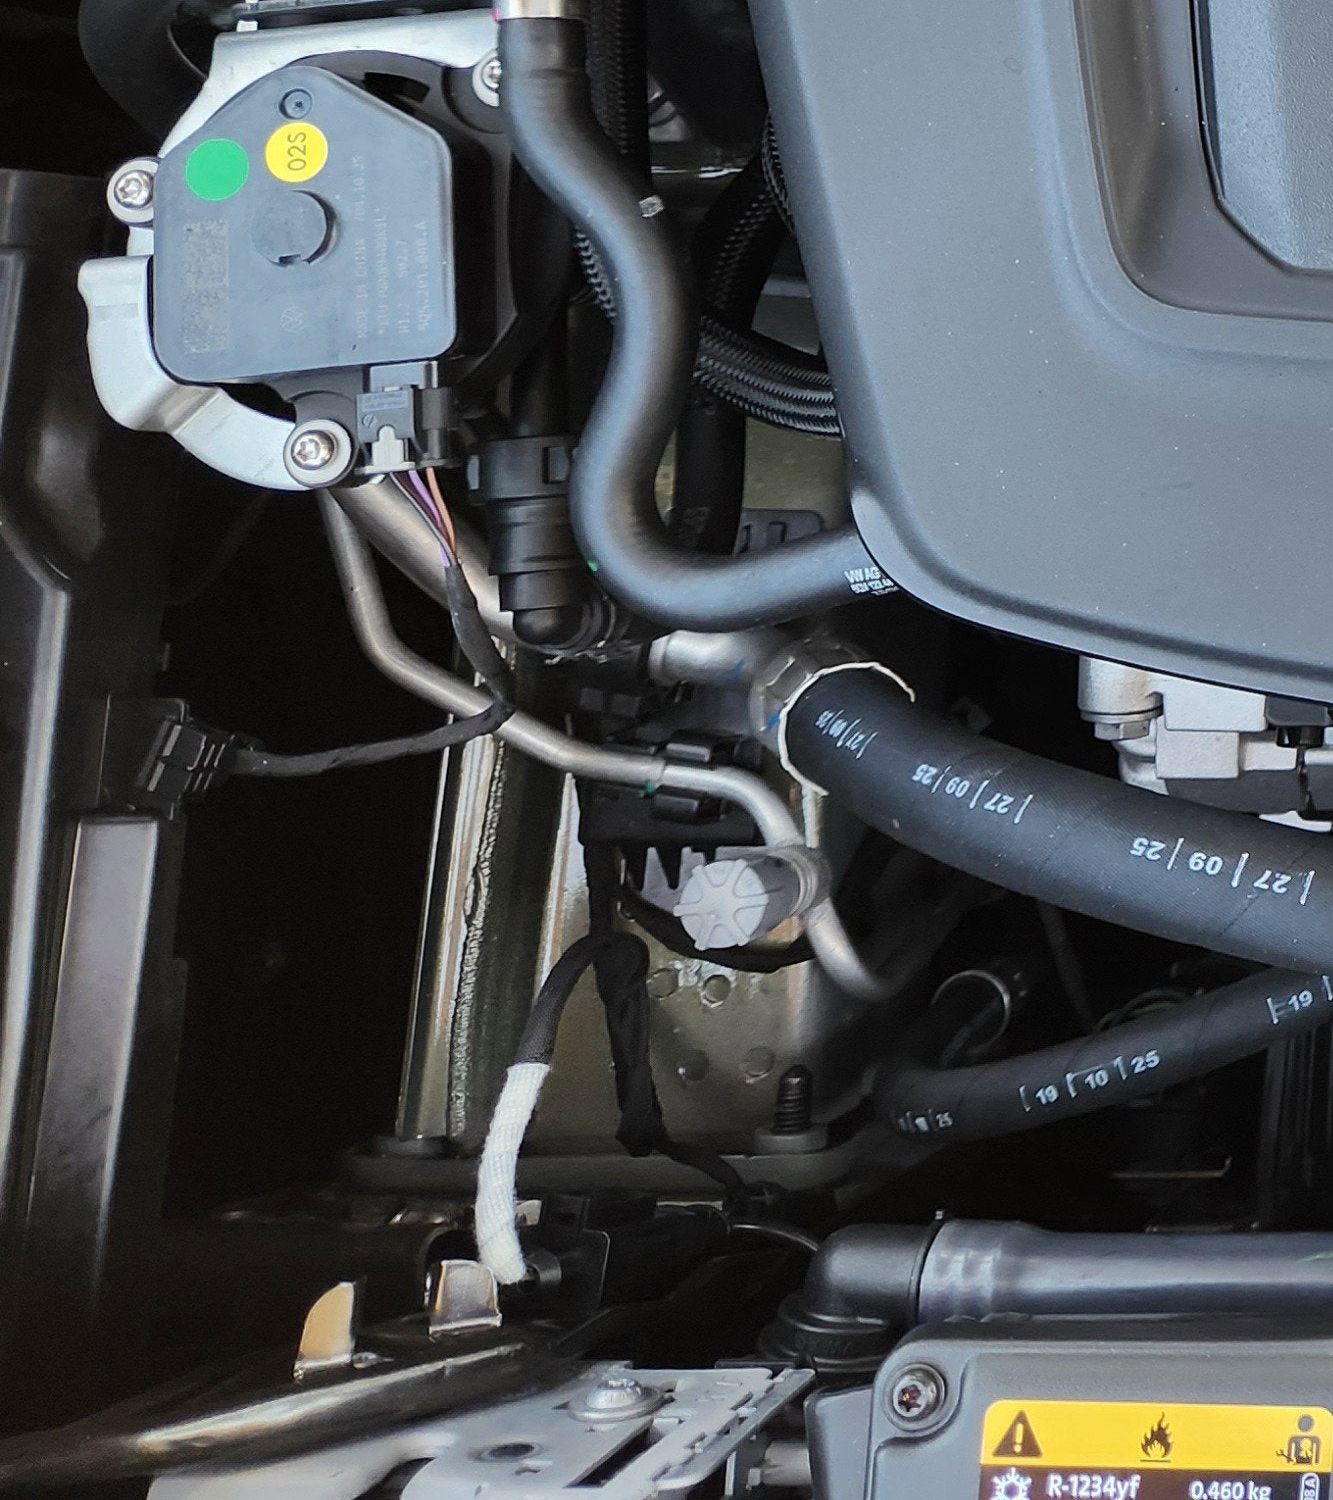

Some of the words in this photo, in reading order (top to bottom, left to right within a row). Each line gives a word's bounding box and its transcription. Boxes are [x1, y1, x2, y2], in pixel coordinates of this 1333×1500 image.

[912, 764, 938, 787] 25
[945, 776, 970, 798] 09
[983, 792, 1013, 814] 27
[1129, 837, 1166, 861] 25
[1188, 852, 1223, 875] 09
[1253, 869, 1292, 894] 27
[1035, 1085, 1058, 1105] 19
[1130, 1049, 1160, 1074] 25
[1046, 1474, 1142, 1500] R-1234yf
[1247, 1481, 1272, 1500] kg
